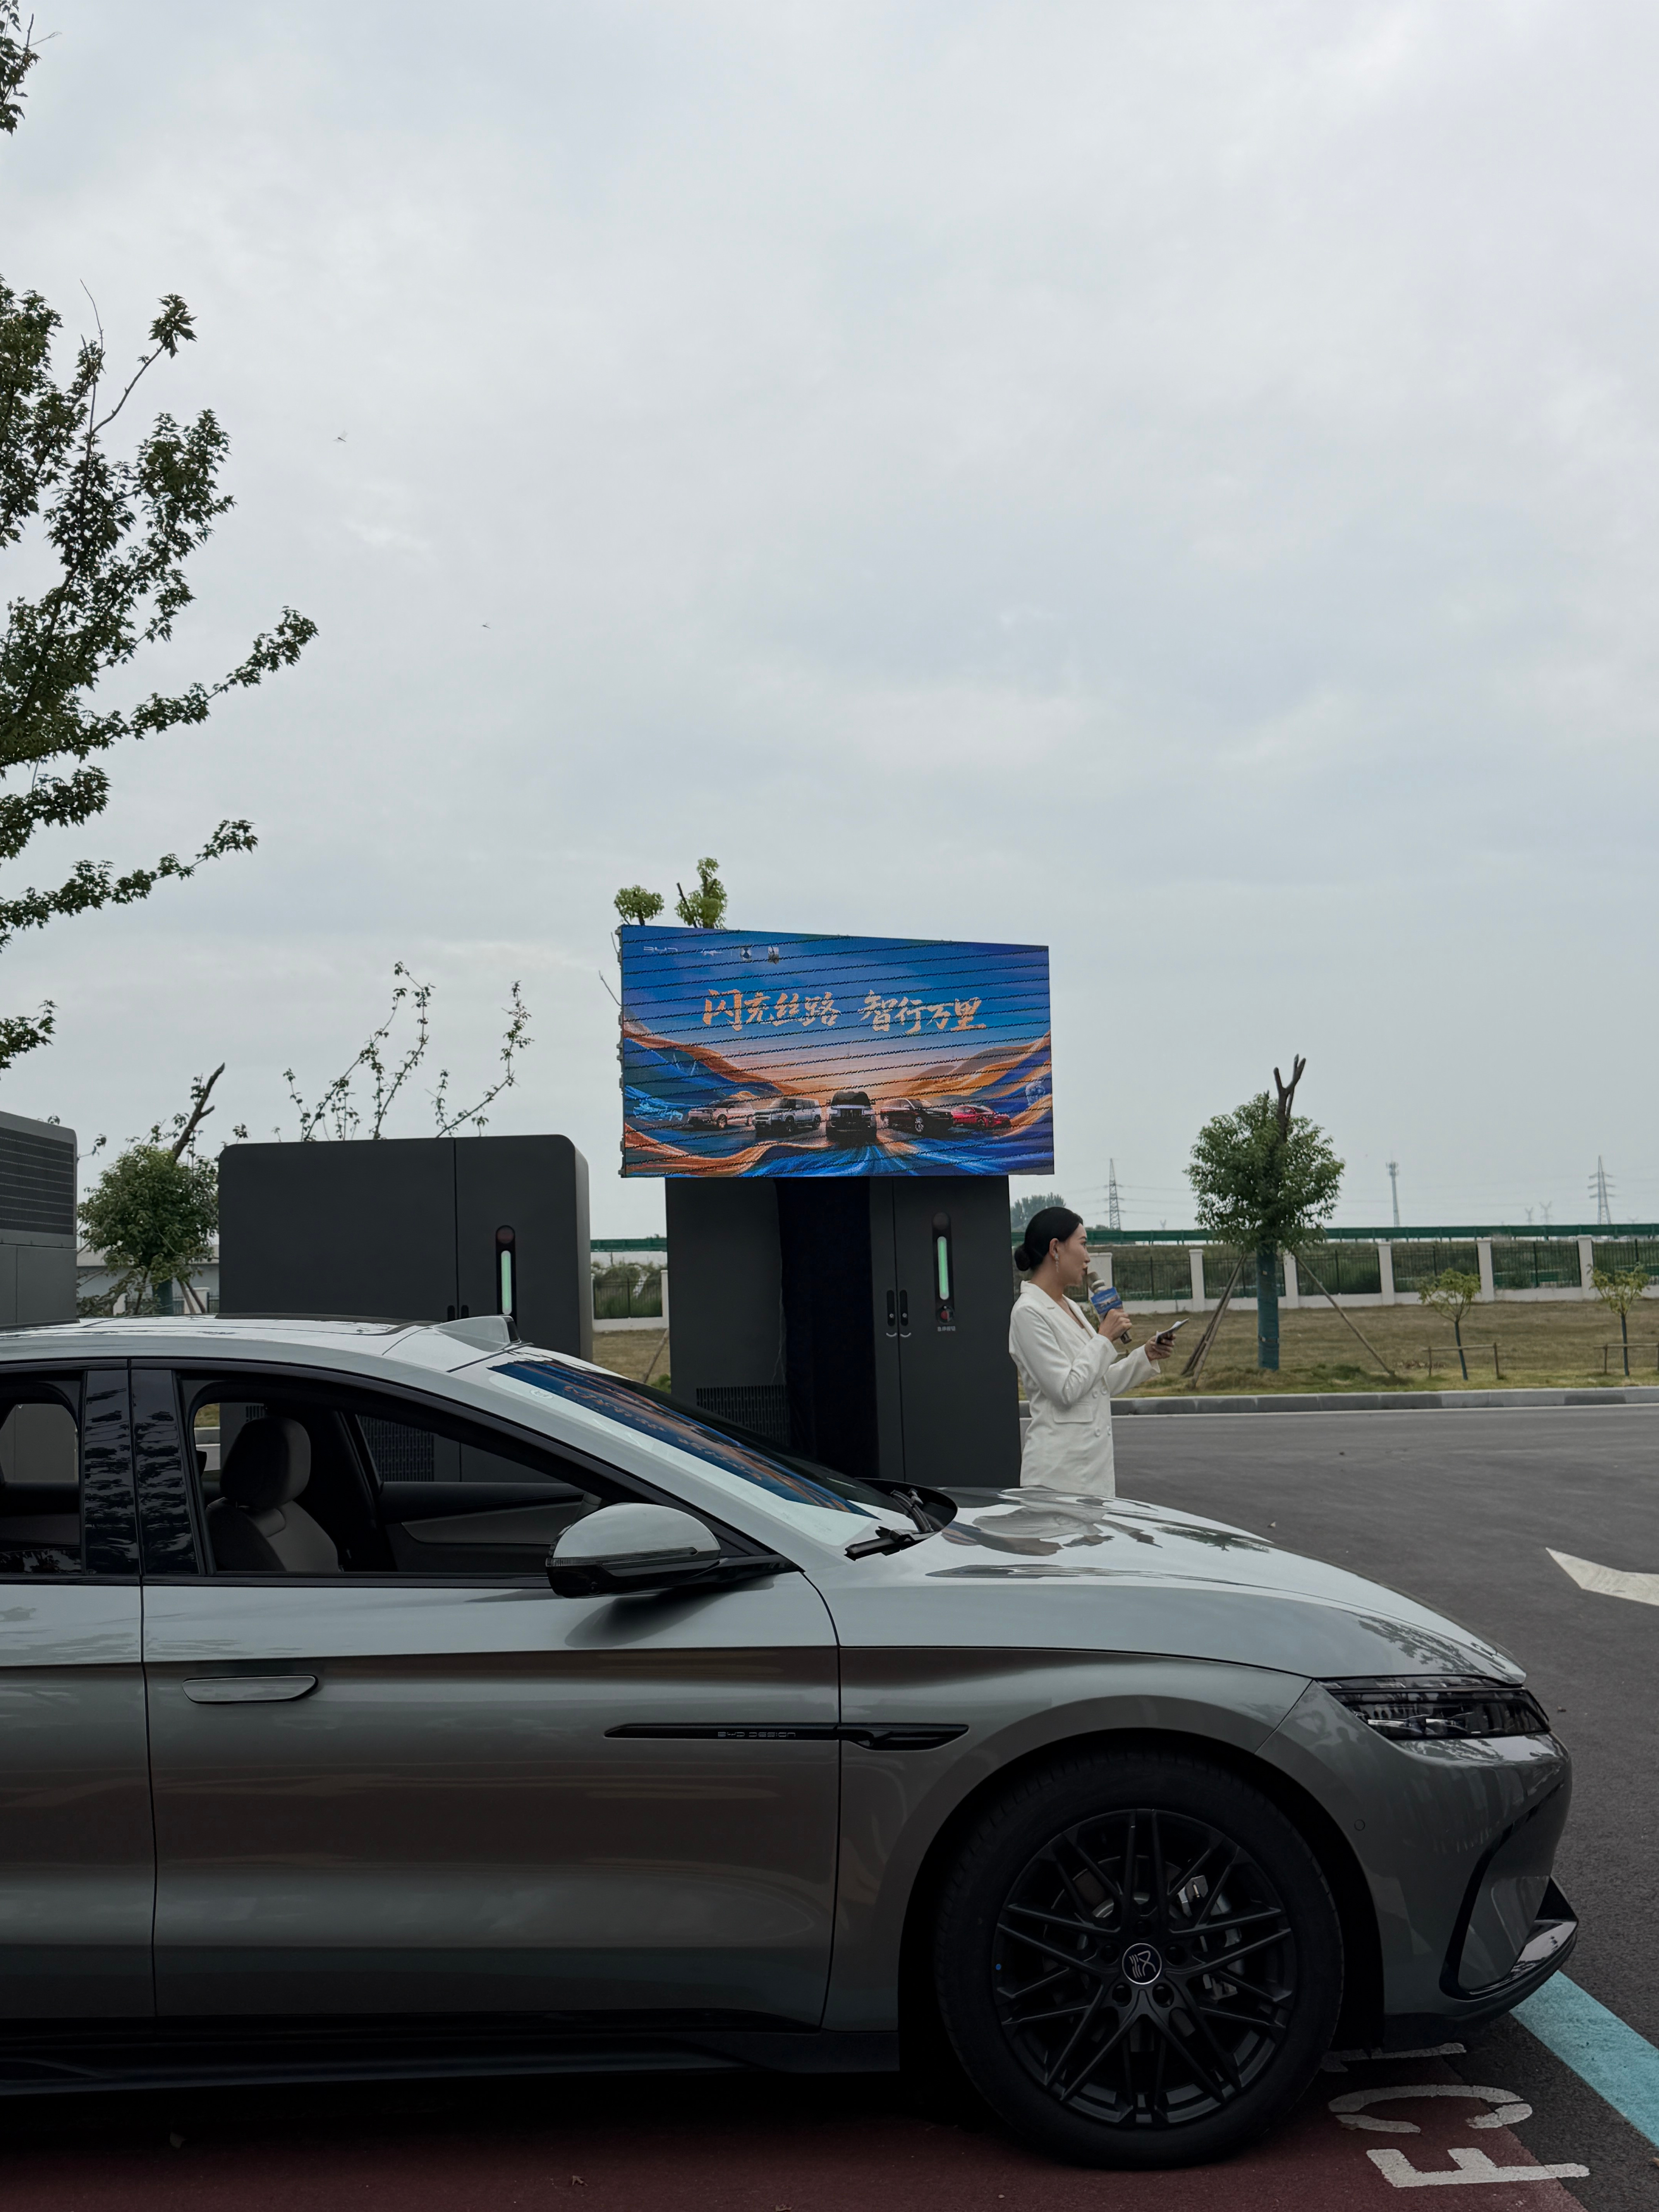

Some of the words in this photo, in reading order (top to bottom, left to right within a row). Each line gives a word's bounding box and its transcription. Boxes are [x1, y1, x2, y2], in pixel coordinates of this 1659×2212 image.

[702, 989, 842, 1032] 闪充丝路
[856, 989, 987, 1036] 智行万里
